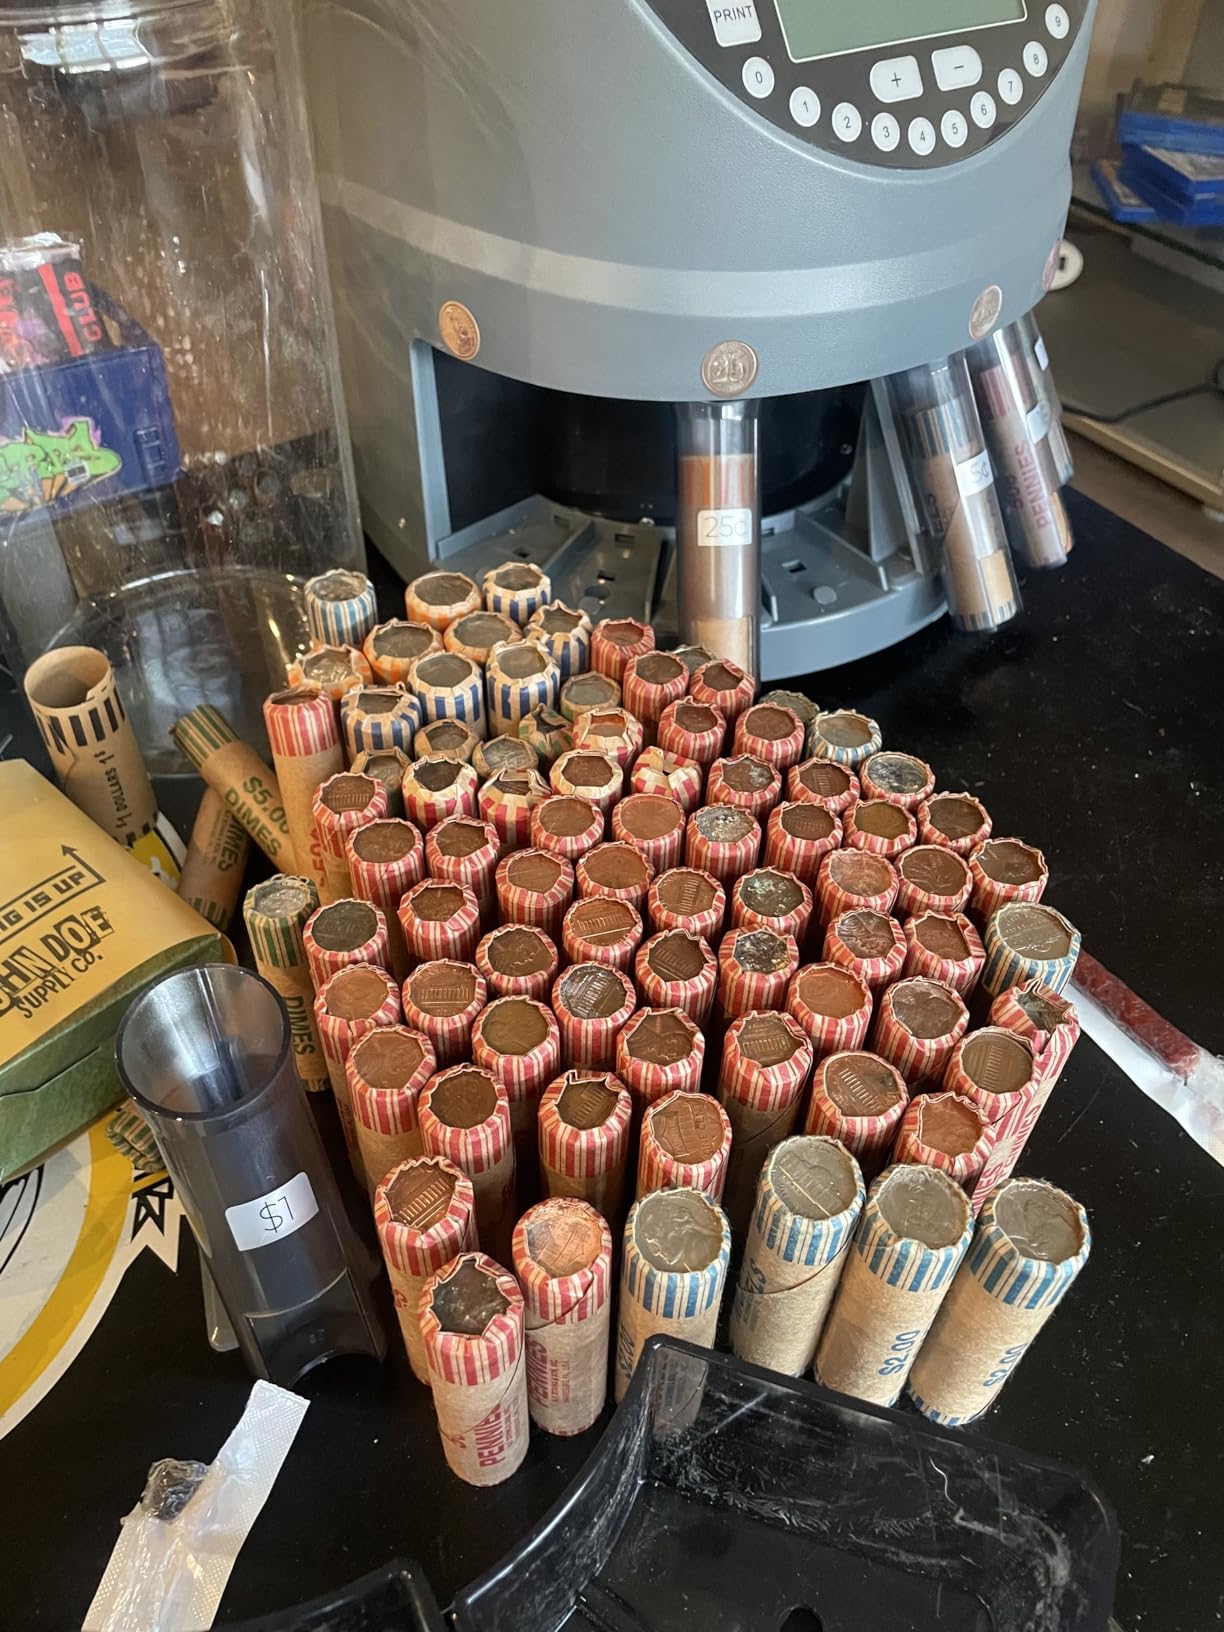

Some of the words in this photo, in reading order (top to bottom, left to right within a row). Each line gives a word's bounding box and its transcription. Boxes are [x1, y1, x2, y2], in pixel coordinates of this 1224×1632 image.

[714, 5, 753, 23] PRINT
[755, 71, 763, 84] 0
[802, 101, 809, 113] 1
[844, 116, 852, 129] 2
[882, 126, 890, 138] 3
[919, 130, 926, 143] 4
[952, 122, 959, 135] 5
[981, 104, 988, 116] 6
[1007, 81, 1013, 93] 7
[1033, 53, 1040, 65] 8
[1055, 16, 1062, 27] 9
[1015, 440, 1050, 529] PENNIES
[105, 767, 128, 812] DOLLARS
[243, 776, 289, 834] $5.00
[216, 815, 249, 872] IMES
[224, 787, 282, 857] DIMES
[24, 891, 52, 913] IS
[52, 871, 86, 895] UP
[40, 905, 115, 963] DOE
[16, 966, 76, 1019] SUPPLY
[71, 950, 104, 973] CO.
[282, 995, 315, 1056] DIMES
[259, 1196, 294, 1234] $1
[878, 1329, 921, 1376] $2.00
[983, 1342, 1030, 1387] $2.00
